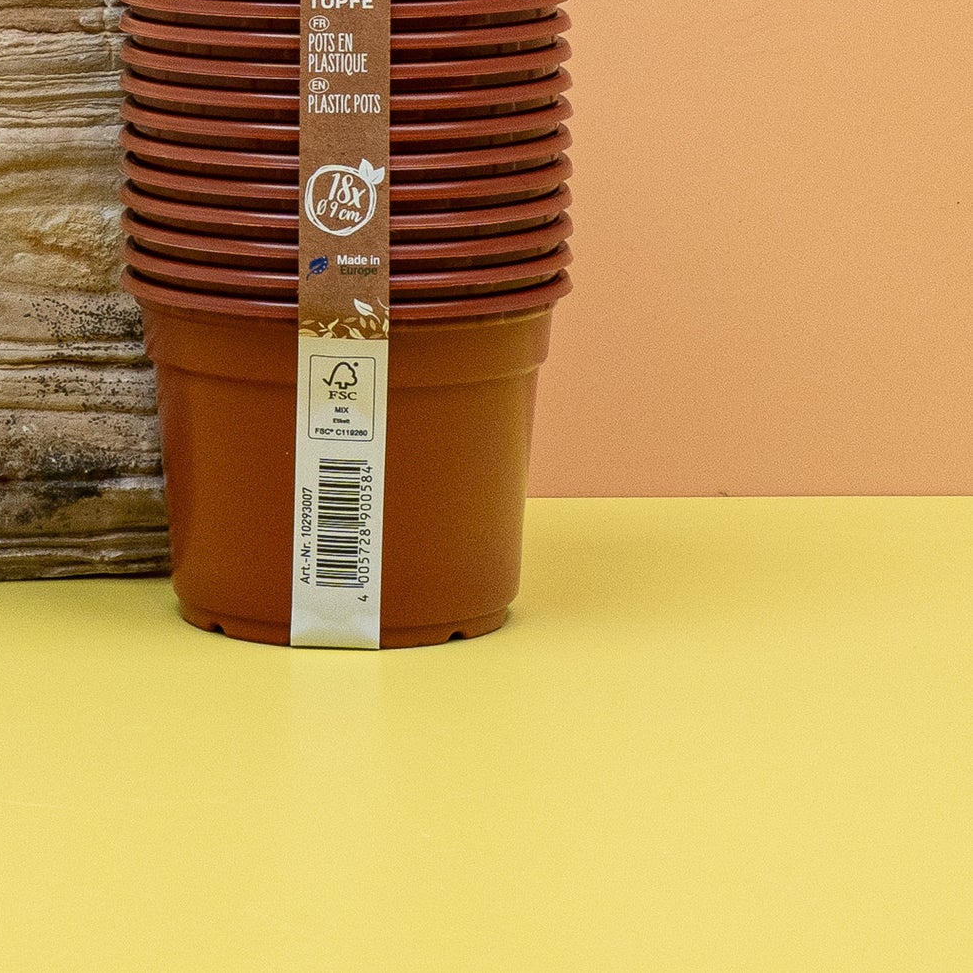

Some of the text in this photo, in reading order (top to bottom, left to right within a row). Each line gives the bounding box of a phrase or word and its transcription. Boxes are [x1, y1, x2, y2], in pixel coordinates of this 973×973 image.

[312, 19, 326, 28] FR
[308, 33, 353, 52] POTS EN
[308, 53, 367, 75] PLASTIQUE
[312, 81, 326, 90] EN
[308, 94, 381, 113] PLASTIC POTS
[328, 173, 366, 209] 18x
[329, 201, 338, 218] 9
[338, 208, 362, 223] cm
[337, 255, 380, 265] Made in
[340, 266, 377, 276] Europe
[328, 391, 357, 400] FSC
[300, 487, 313, 584] Art.-Nr. 10293007
[357, 465, 373, 602] 4 005728 900584
